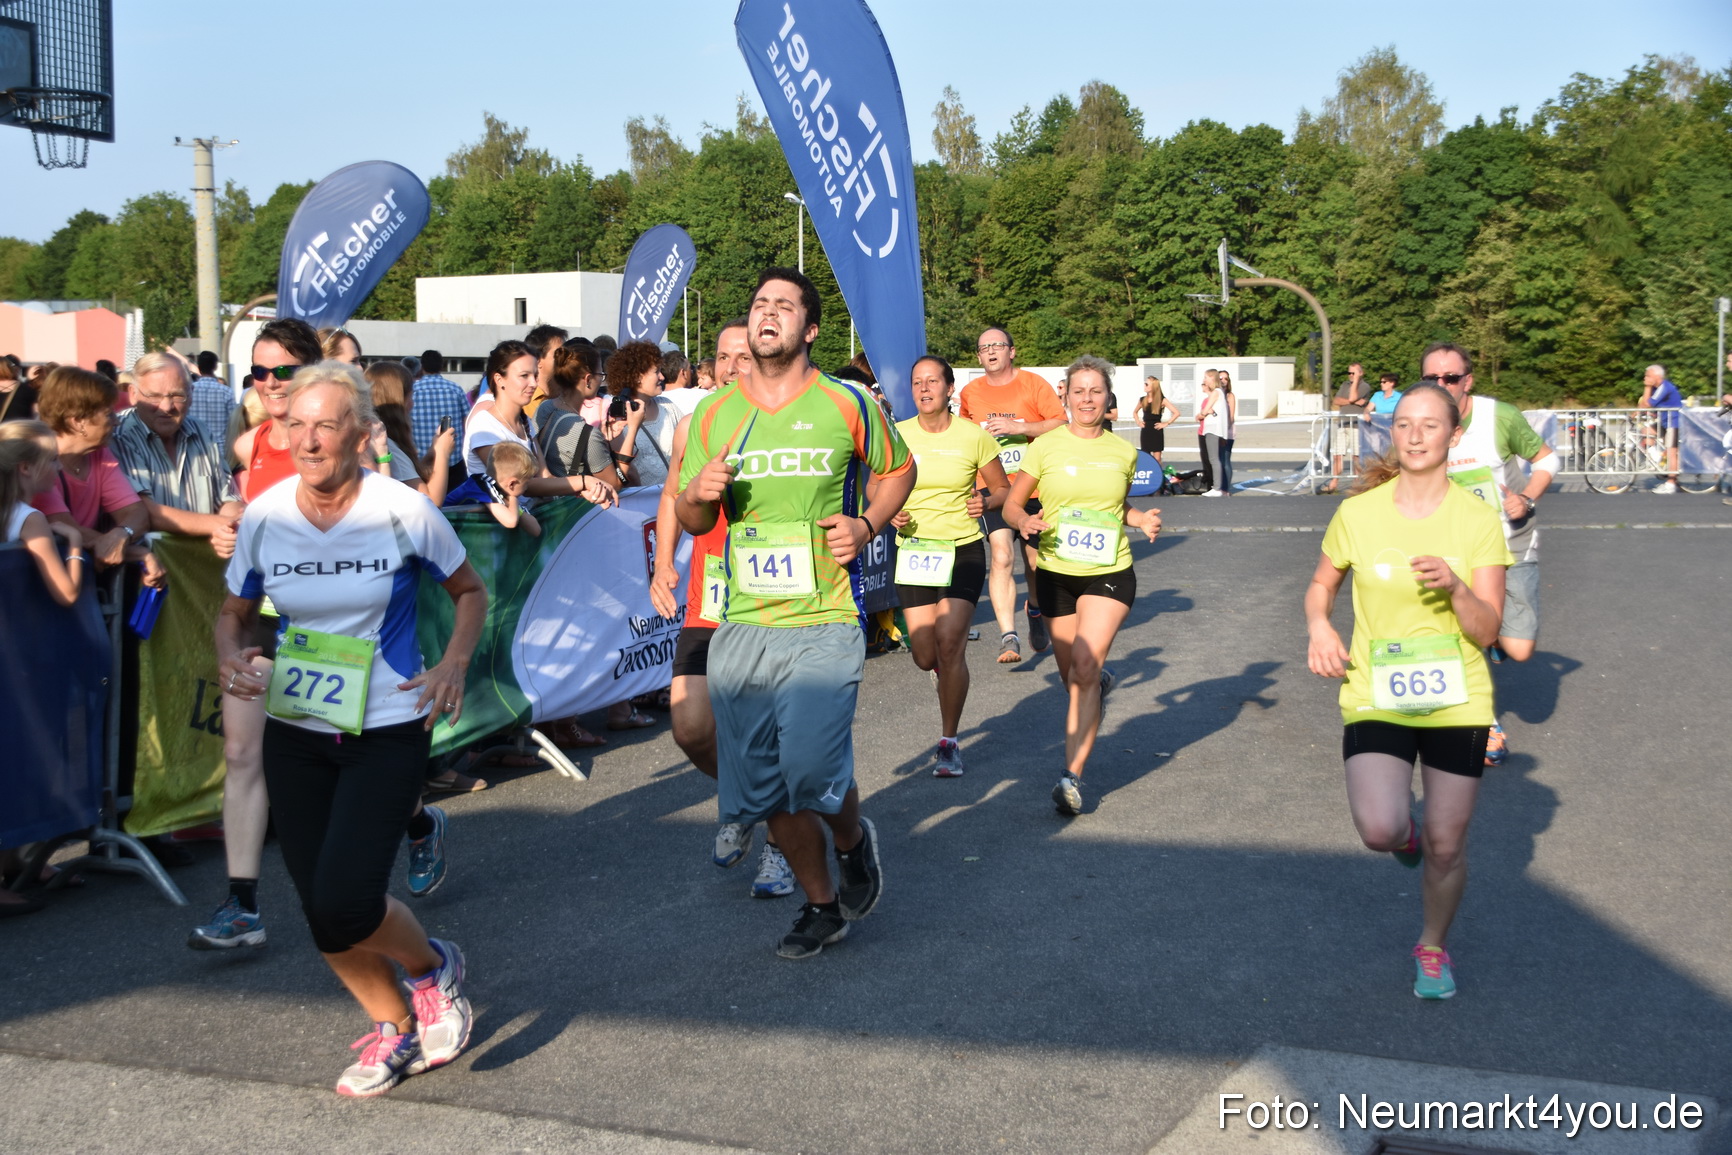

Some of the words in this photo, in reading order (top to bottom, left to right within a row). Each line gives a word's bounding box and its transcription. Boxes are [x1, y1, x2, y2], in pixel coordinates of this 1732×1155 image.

[310, 189, 397, 298] Fischer
[337, 211, 407, 298] AUTOMOBILE
[637, 243, 680, 325] Fischer
[652, 259, 684, 324] AUTOMOBILE
[1067, 529, 1105, 551] 643
[273, 558, 388, 577] DELPHI
[748, 553, 793, 578] 141
[908, 554, 943, 572] 647
[283, 666, 346, 705] 272
[1389, 669, 1447, 697] 663
